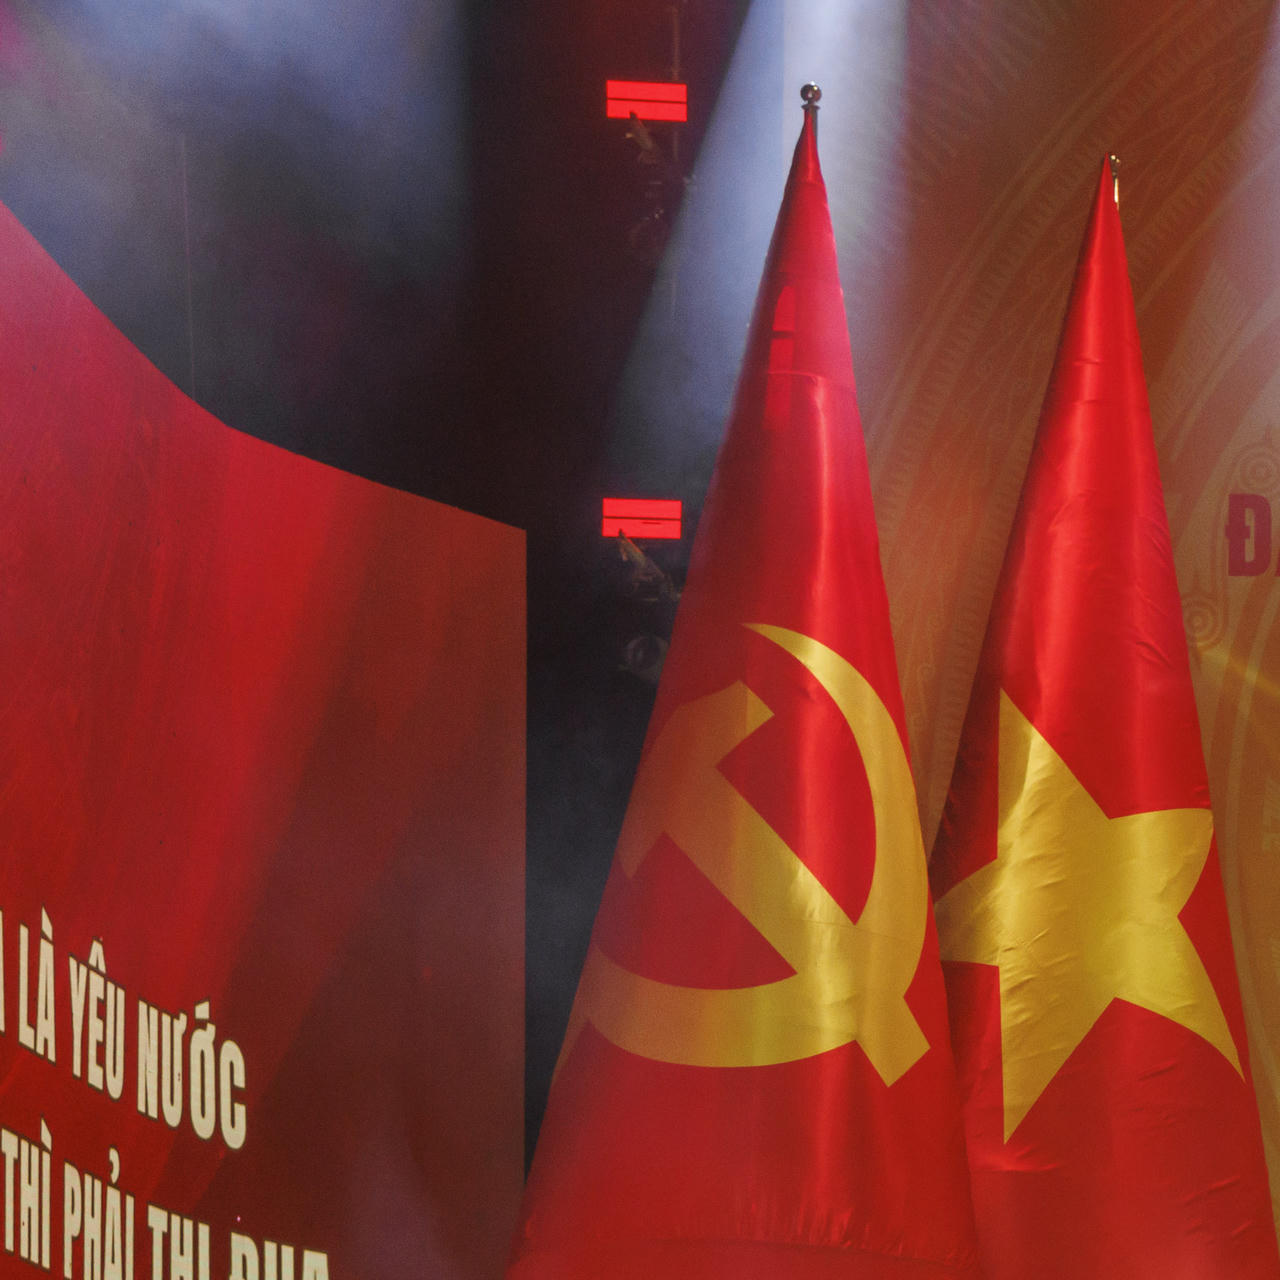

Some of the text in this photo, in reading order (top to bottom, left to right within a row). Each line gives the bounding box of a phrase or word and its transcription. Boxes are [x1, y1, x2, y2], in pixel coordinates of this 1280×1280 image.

[18, 905, 57, 1063] LÀ
[69, 937, 126, 1100] YÊU
[137, 1000, 247, 1151] NƯỚC
[1, 1117, 52, 1270] THÌ
